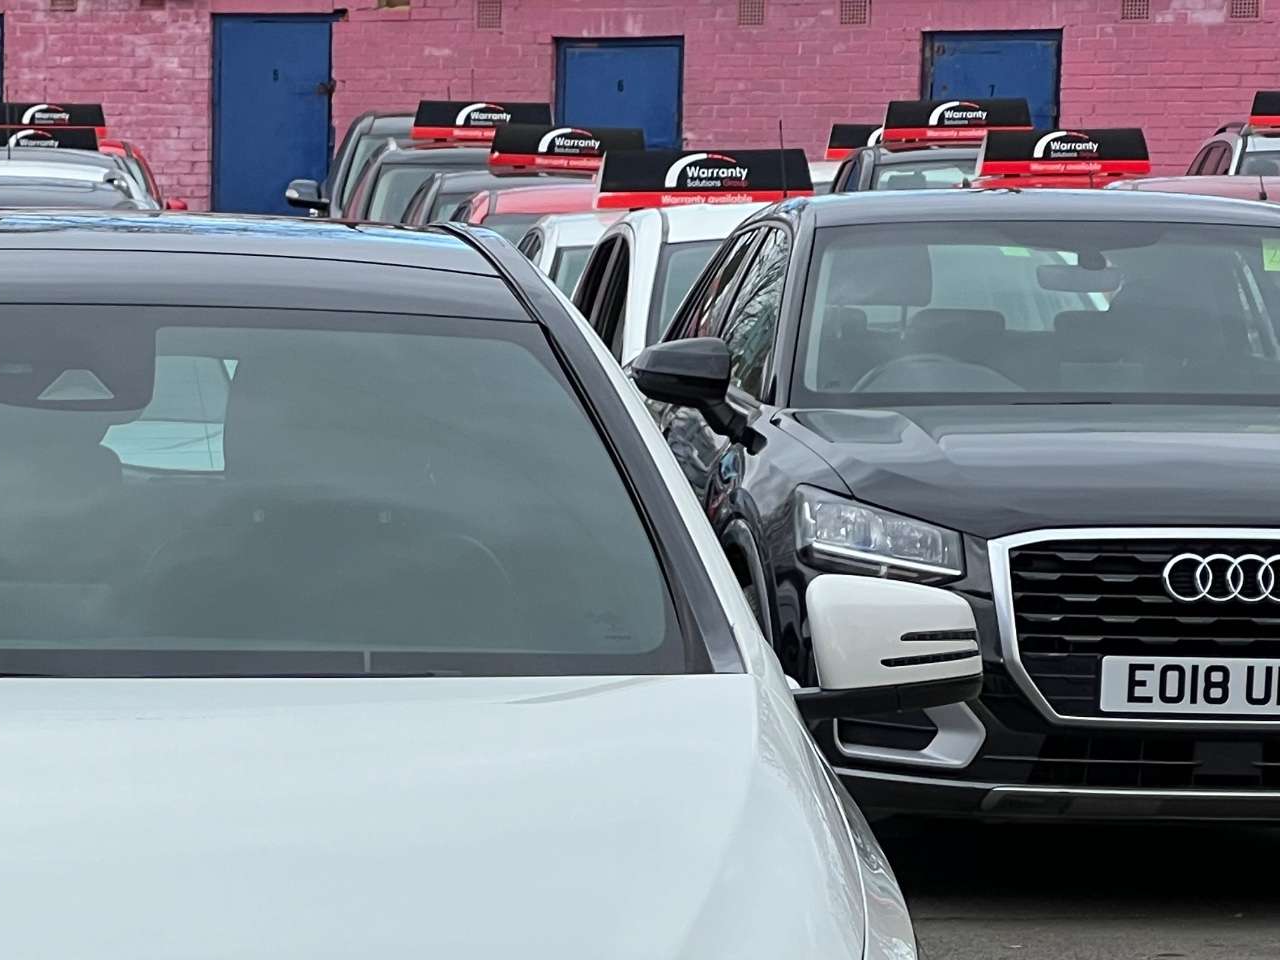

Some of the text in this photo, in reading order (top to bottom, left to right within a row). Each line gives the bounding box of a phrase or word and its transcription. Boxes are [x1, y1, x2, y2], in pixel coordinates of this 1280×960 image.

[470, 111, 511, 122] Warranty
[944, 110, 988, 120] Warranty
[554, 137, 601, 150] Warranty
[1050, 141, 1099, 153] Warranty
[686, 166, 748, 180] Warranty
[686, 178, 721, 188] Solutions
[661, 193, 753, 204] Warranty available
[1126, 663, 1280, 706] EO18 U
